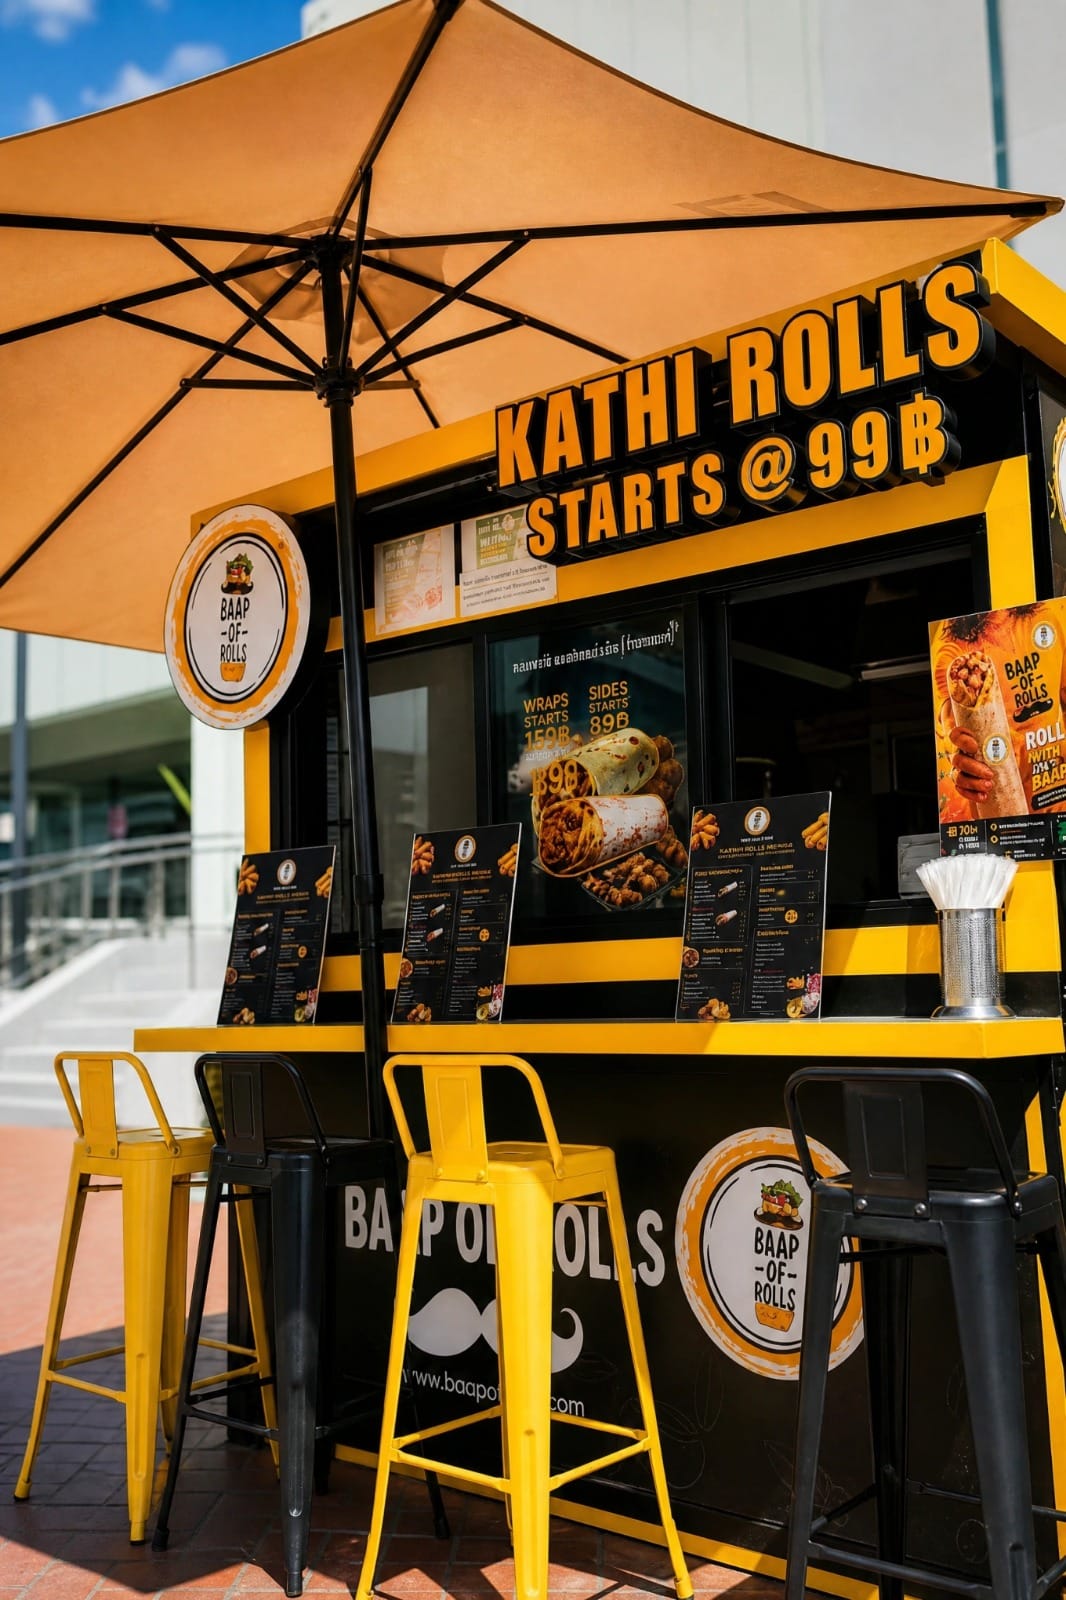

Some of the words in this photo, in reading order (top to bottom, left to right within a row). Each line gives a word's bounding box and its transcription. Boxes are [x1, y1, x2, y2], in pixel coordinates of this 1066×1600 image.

[497, 352, 698, 488] KATHI
[728, 265, 980, 425] ROLLS
[527, 452, 724, 558] STARTS
[220, 596, 250, 621] BAAP
[220, 643, 247, 663] ROLLS
[1004, 651, 1040, 681] BAAP
[523, 692, 569, 714] WRAPS
[588, 680, 628, 701] SIDES
[1014, 683, 1048, 709] ROLLS
[588, 697, 629, 714] STARTS
[524, 710, 569, 728] STARTS
[344, 1185, 445, 1257] BAP
[552, 1202, 666, 1287] OLS
[754, 1226, 800, 1260] BAAP
[754, 1280, 796, 1312] ROLLS
